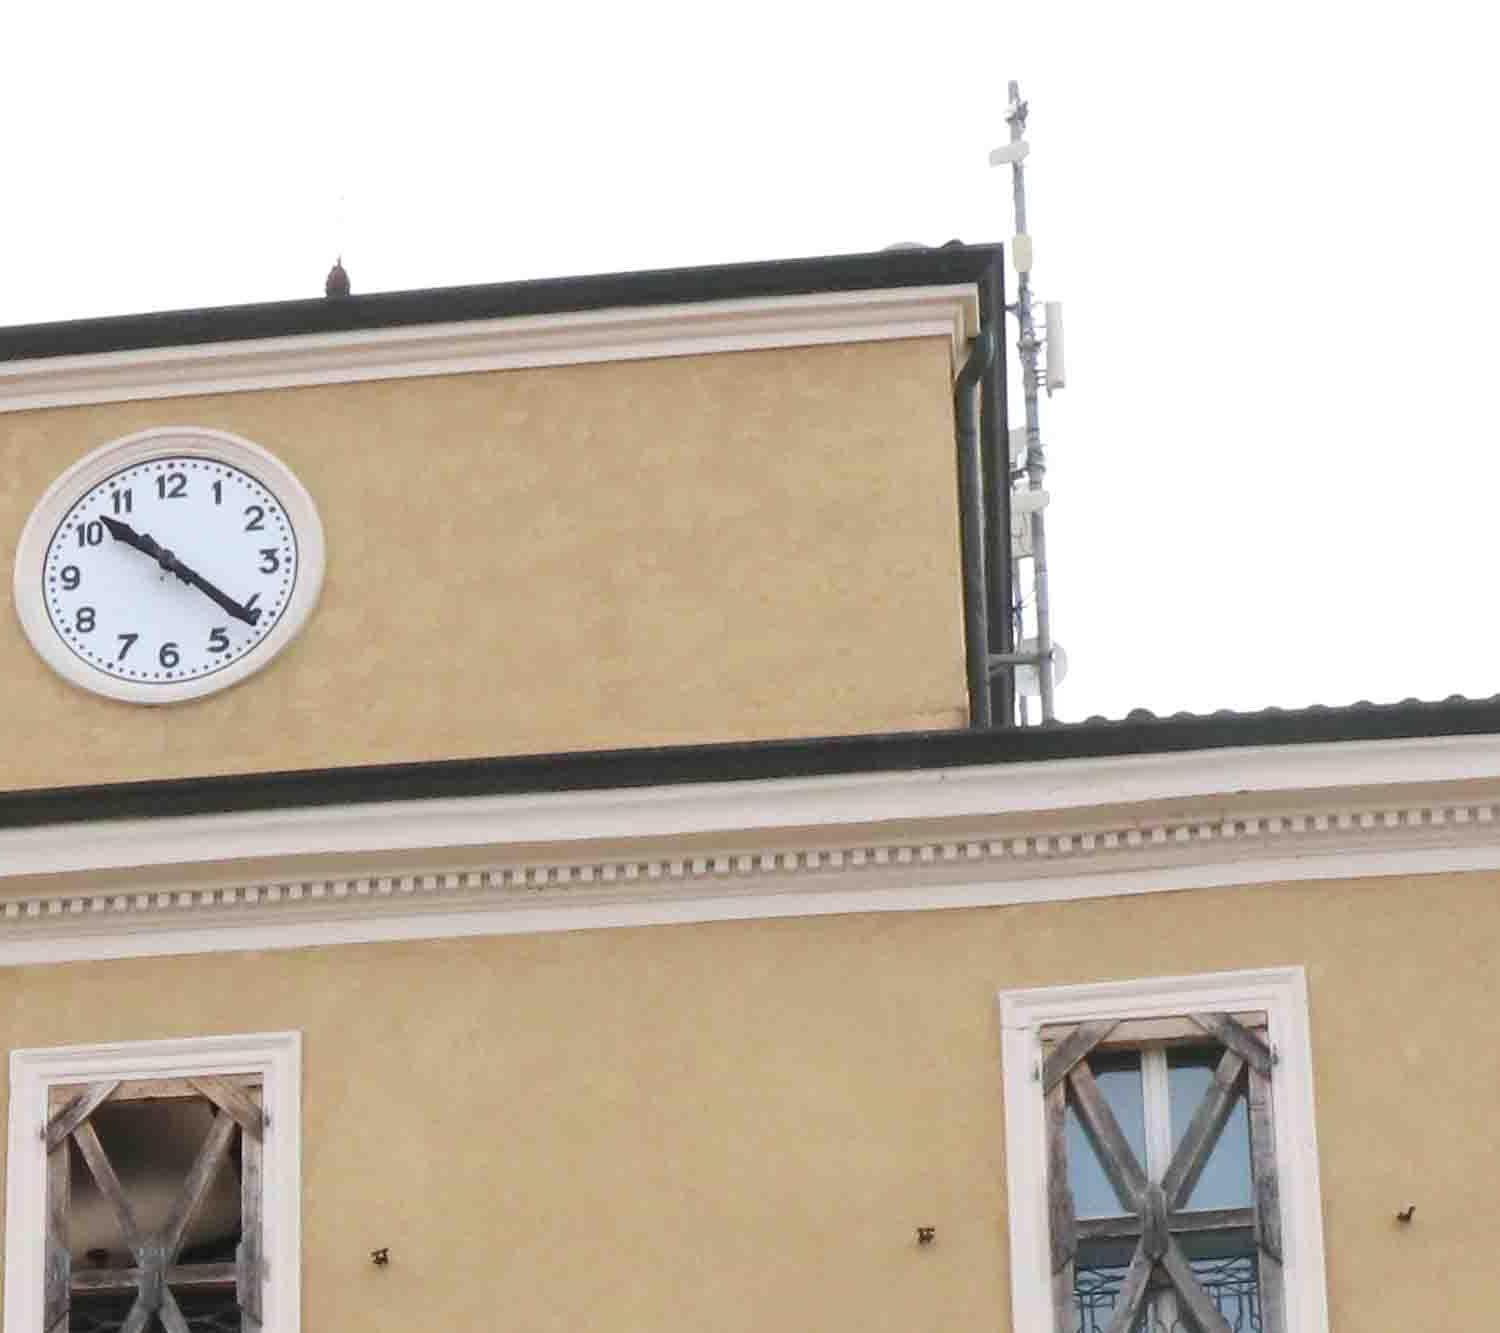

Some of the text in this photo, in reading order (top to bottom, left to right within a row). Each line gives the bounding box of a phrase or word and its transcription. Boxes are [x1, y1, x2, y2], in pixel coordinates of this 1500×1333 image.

[157, 473, 187, 499] 12
[213, 481, 222, 504] 1
[112, 488, 133, 514] 11
[244, 506, 265, 531] 2
[77, 521, 103, 547] 10
[259, 548, 280, 574] 3
[60, 565, 80, 591] 9
[76, 607, 96, 633] 8
[118, 633, 139, 661] 7
[208, 627, 231, 653] 5
[159, 643, 180, 669] 6
